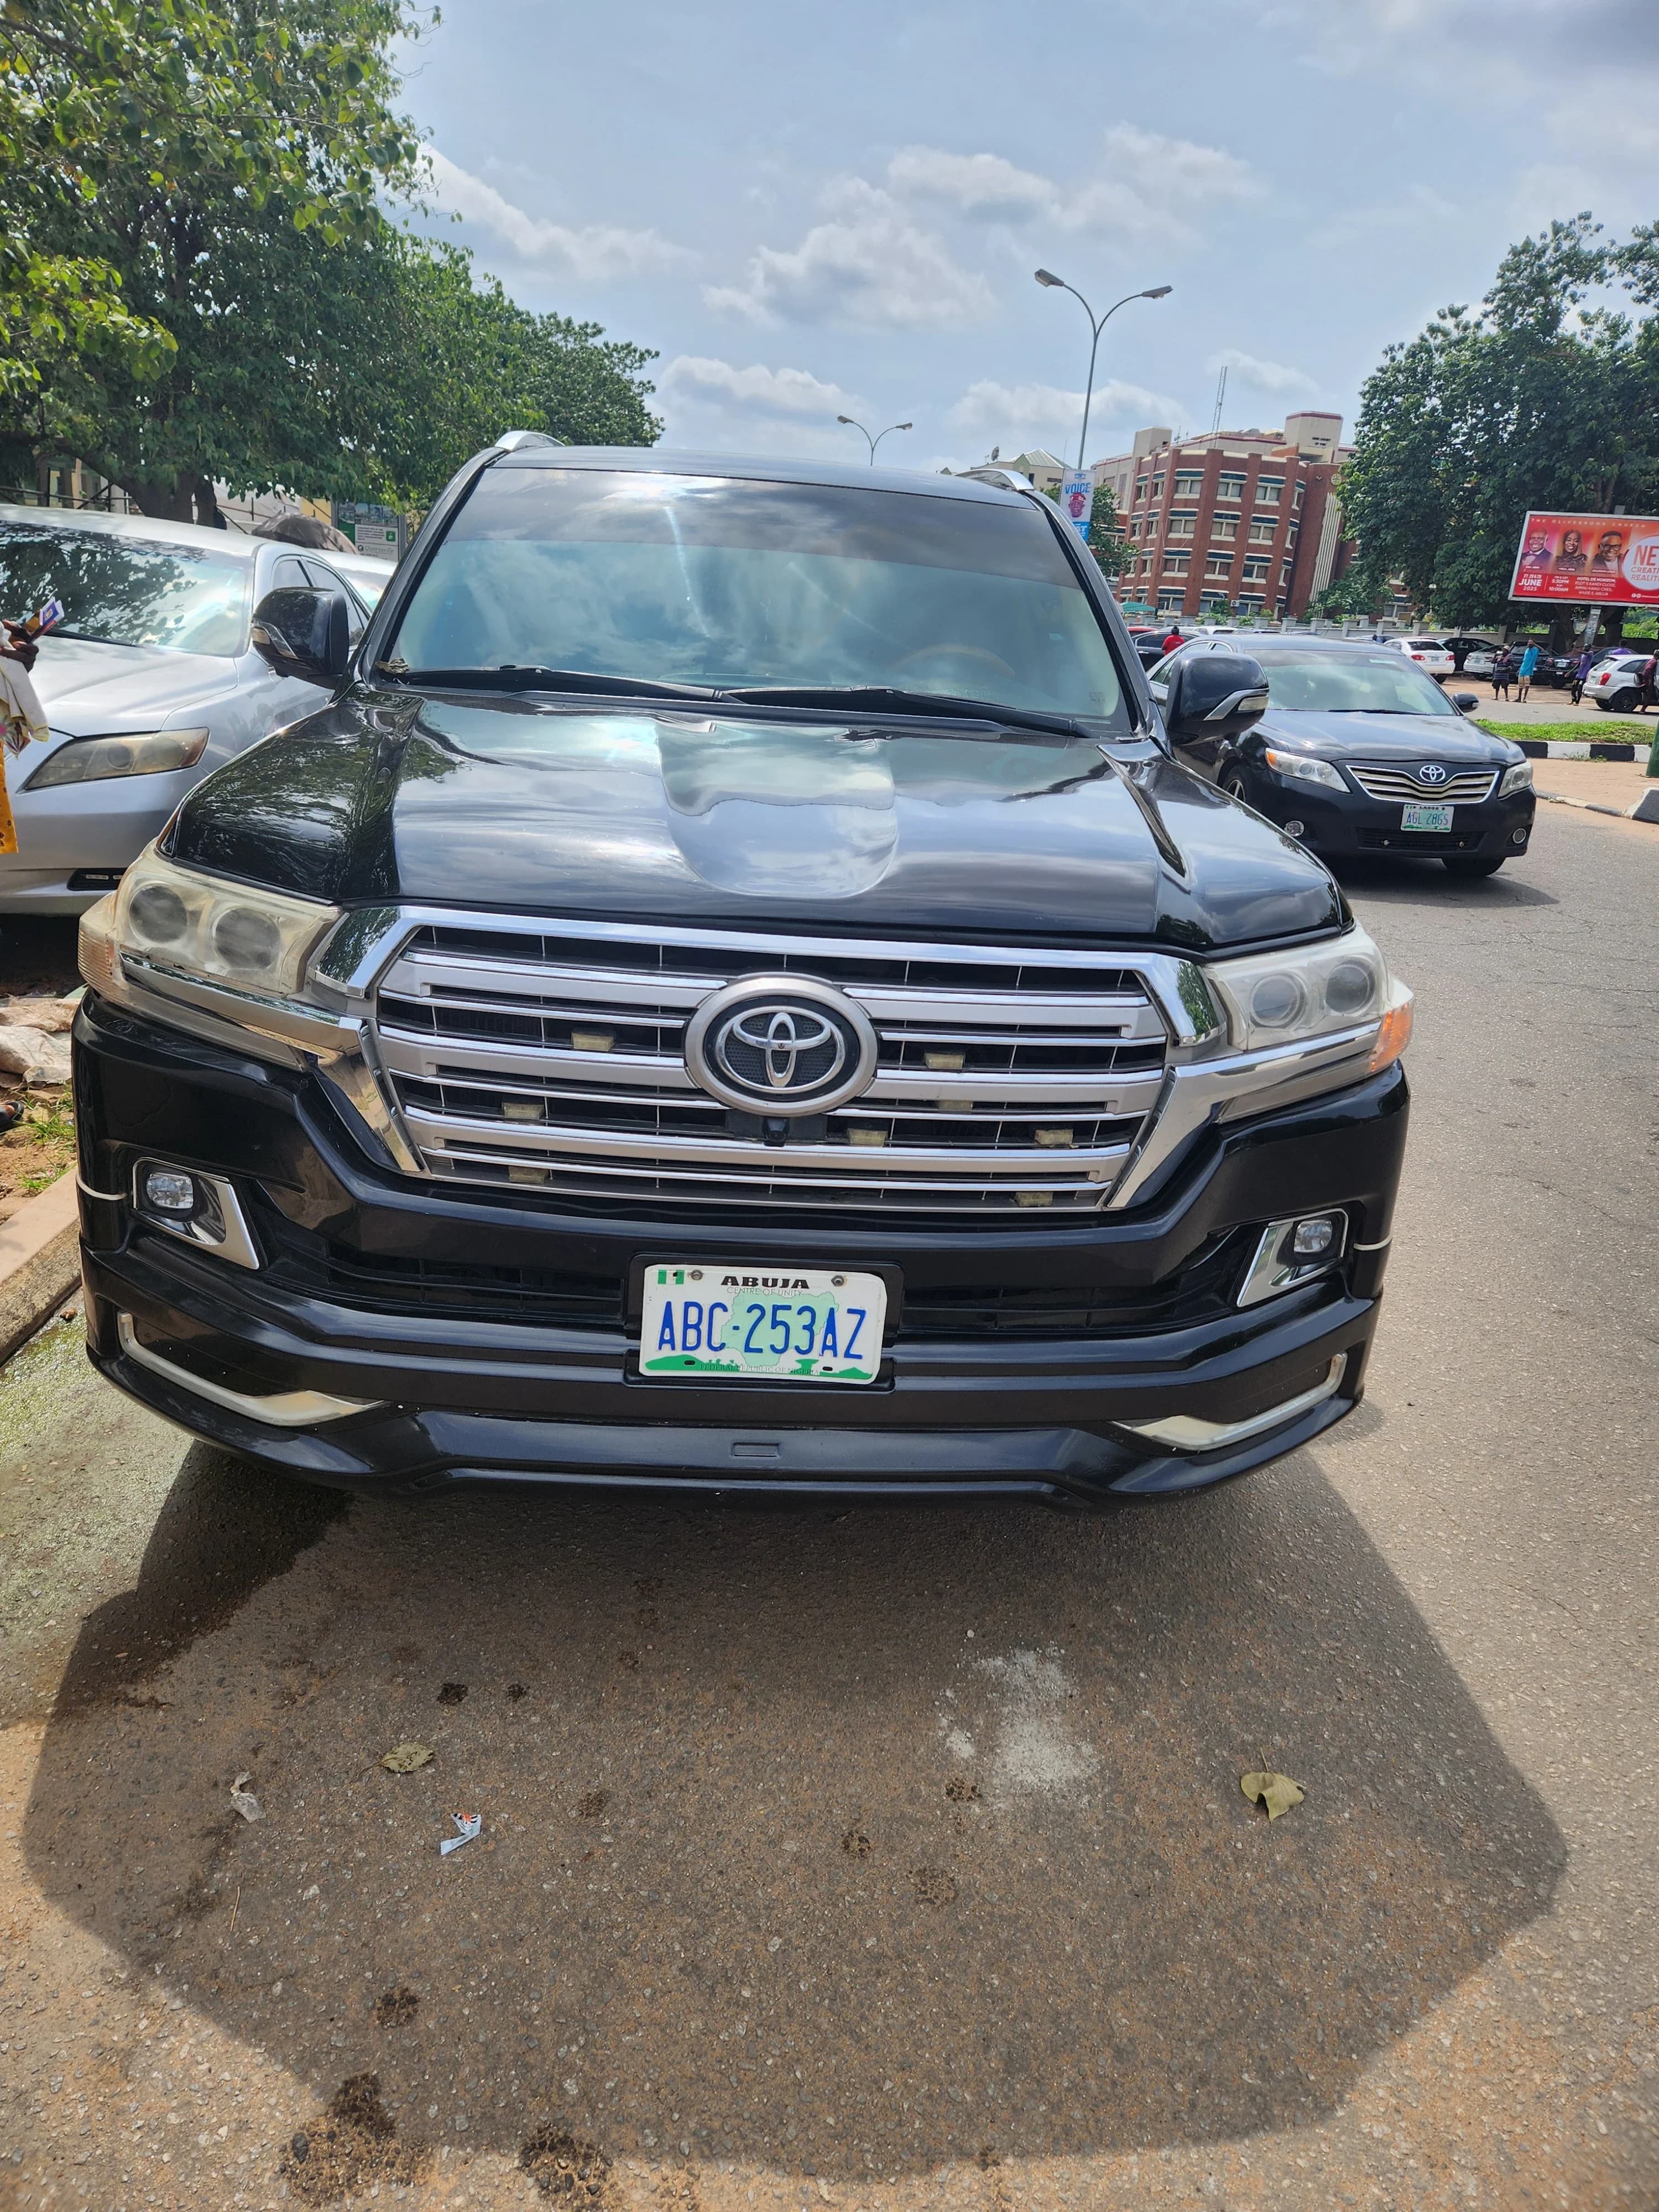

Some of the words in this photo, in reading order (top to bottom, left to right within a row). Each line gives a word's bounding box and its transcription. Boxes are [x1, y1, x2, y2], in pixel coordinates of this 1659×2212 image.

[1065, 482, 1091, 494] VOICE
[1634, 545, 1659, 566] NE
[721, 1276, 810, 1289] ABUJA
[727, 1287, 760, 1295] CENTRE
[658, 1301, 867, 1359] ABC-253AZ
[737, 1364, 774, 1373] REPUBLIC
